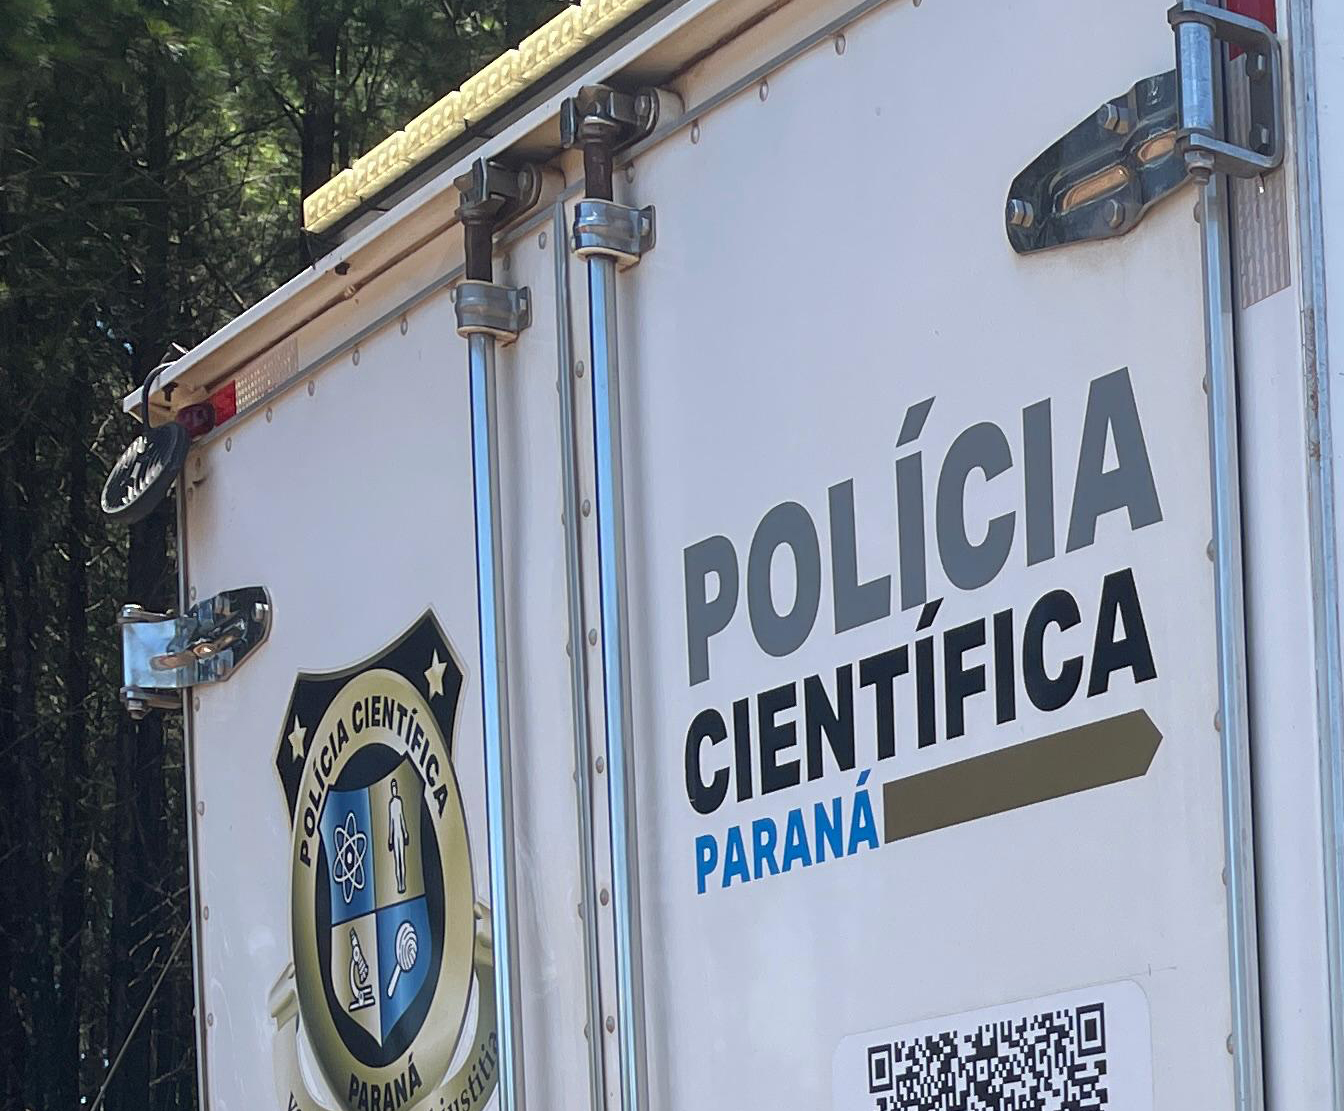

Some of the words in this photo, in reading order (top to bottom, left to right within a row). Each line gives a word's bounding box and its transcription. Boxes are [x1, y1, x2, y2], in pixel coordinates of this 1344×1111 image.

[683, 366, 1163, 687] POLÍCIA
[300, 718, 349, 868] POLÍCIA
[352, 695, 449, 819] CIENTÍFICA
[684, 567, 1158, 815] CIENTÍFICA
[695, 768, 880, 895] PARANÁ
